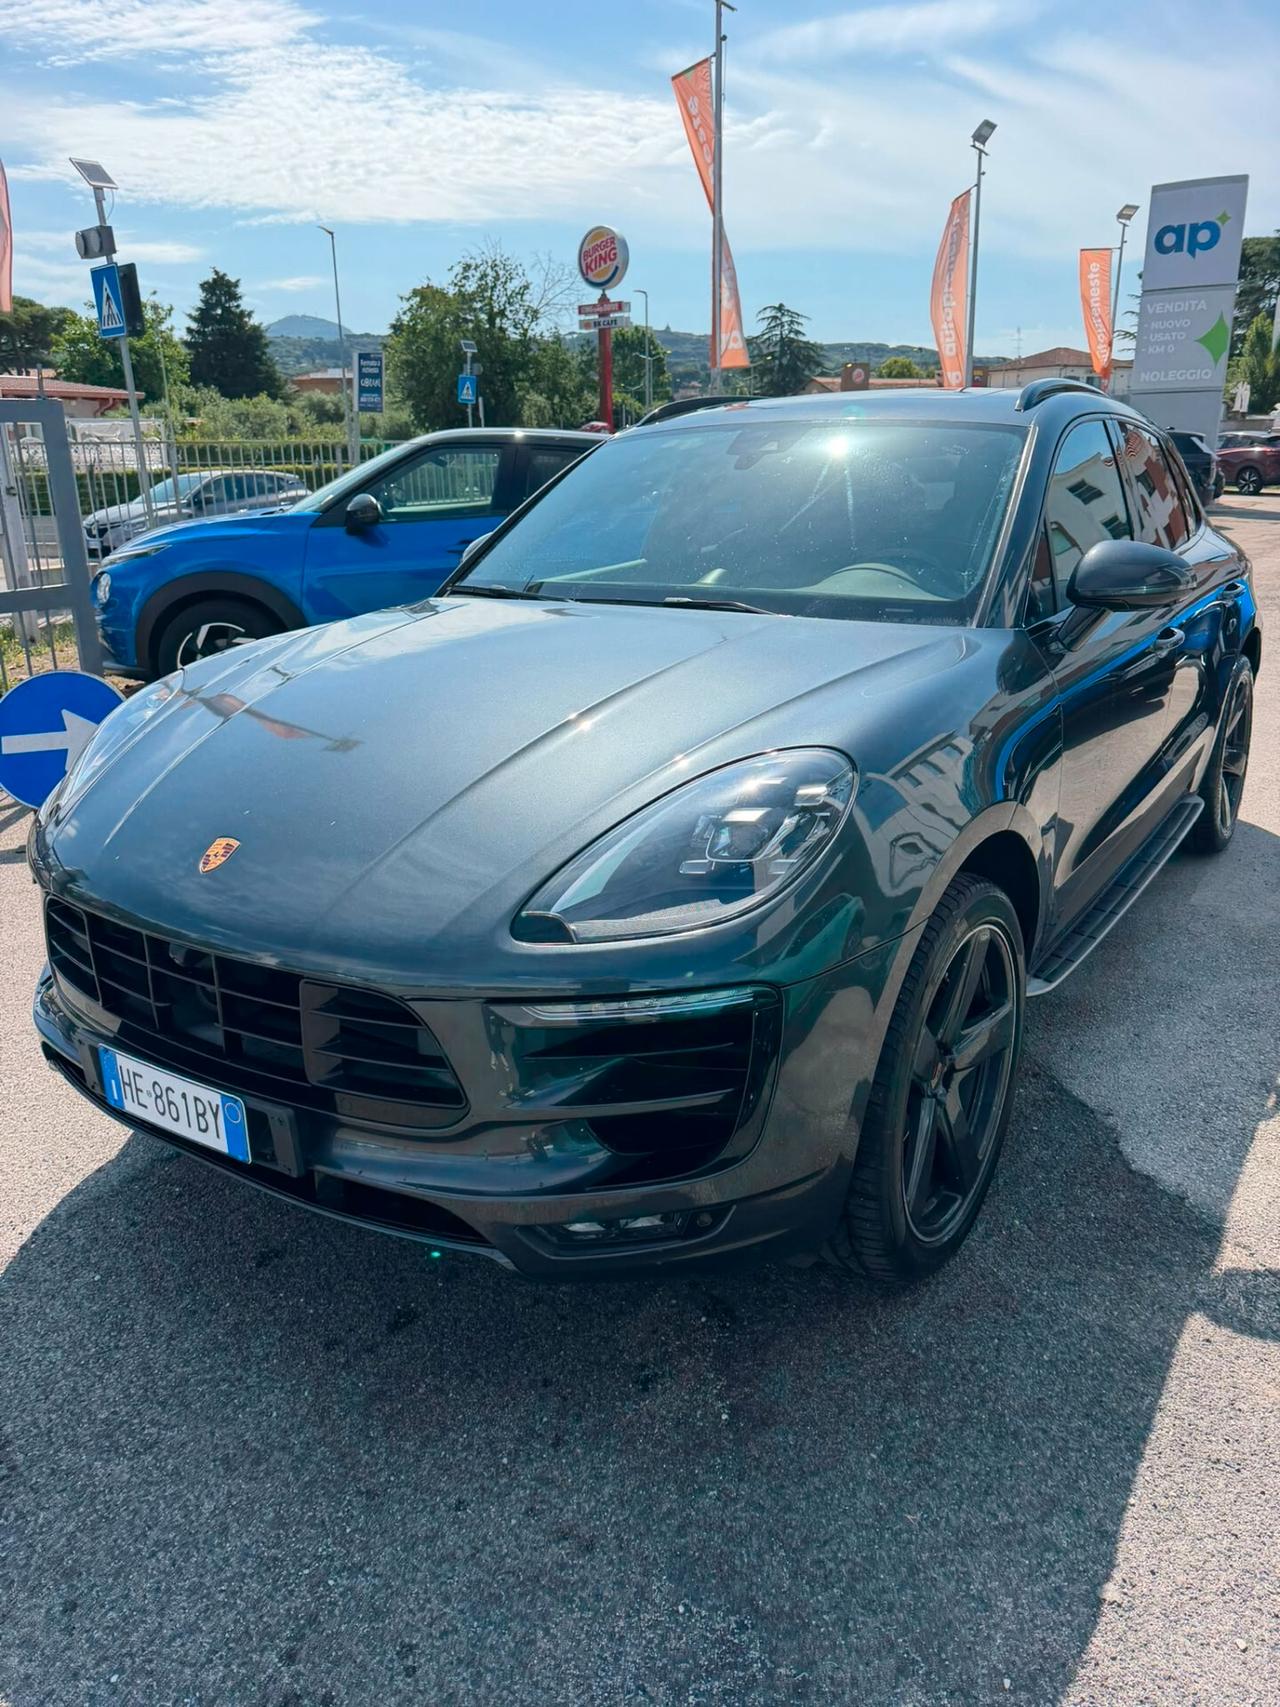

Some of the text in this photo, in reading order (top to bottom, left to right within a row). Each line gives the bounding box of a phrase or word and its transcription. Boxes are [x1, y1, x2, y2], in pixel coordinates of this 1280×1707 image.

[1154, 220, 1221, 259] ap
[583, 236, 616, 262] BURGER
[584, 247, 618, 276] KING
[1147, 299, 1208, 314] VENDITA
[1151, 319, 1191, 330] NUOVO
[1150, 331, 1187, 343] USATO
[1147, 345, 1165, 354] KM
[1140, 368, 1212, 382] NOLEGGIO
